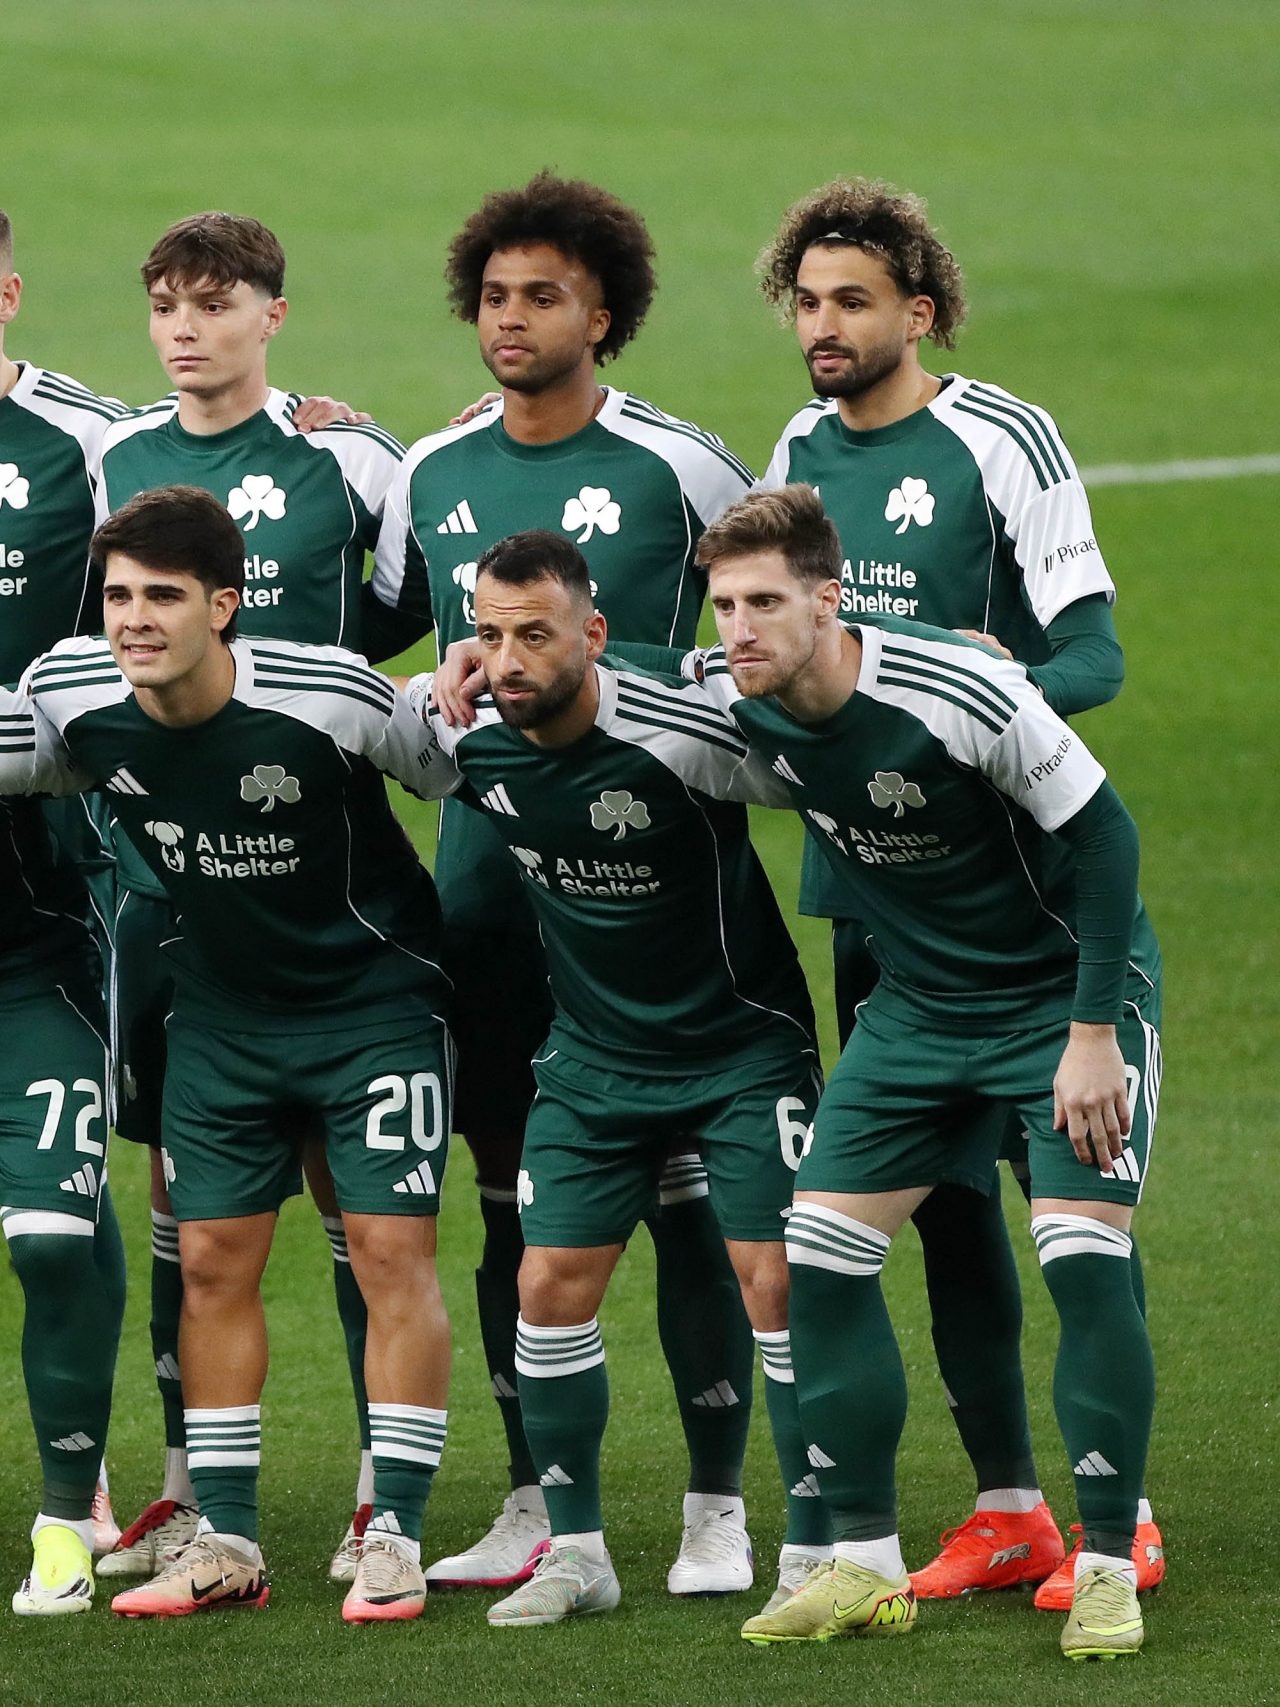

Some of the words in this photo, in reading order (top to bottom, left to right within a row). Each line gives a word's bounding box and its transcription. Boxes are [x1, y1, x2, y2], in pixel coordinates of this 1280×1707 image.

[1056, 538, 1097, 563] Pirae
[243, 554, 280, 580] tle
[841, 559, 854, 584] A
[858, 560, 917, 589] Little
[840, 587, 919, 617] Shelter
[1030, 734, 1072, 782] Piraeus
[196, 832, 216, 855] A
[219, 834, 295, 855] Little
[848, 826, 869, 844] A
[866, 829, 940, 847] Little
[856, 844, 951, 865] Shelter
[199, 857, 300, 879] Shelter
[556, 857, 576, 877] A
[577, 859, 653, 879] Little
[560, 878, 660, 897] Shelter
[25, 1078, 104, 1158] 72
[365, 1072, 443, 1152] 20
[775, 1096, 808, 1172] 6
